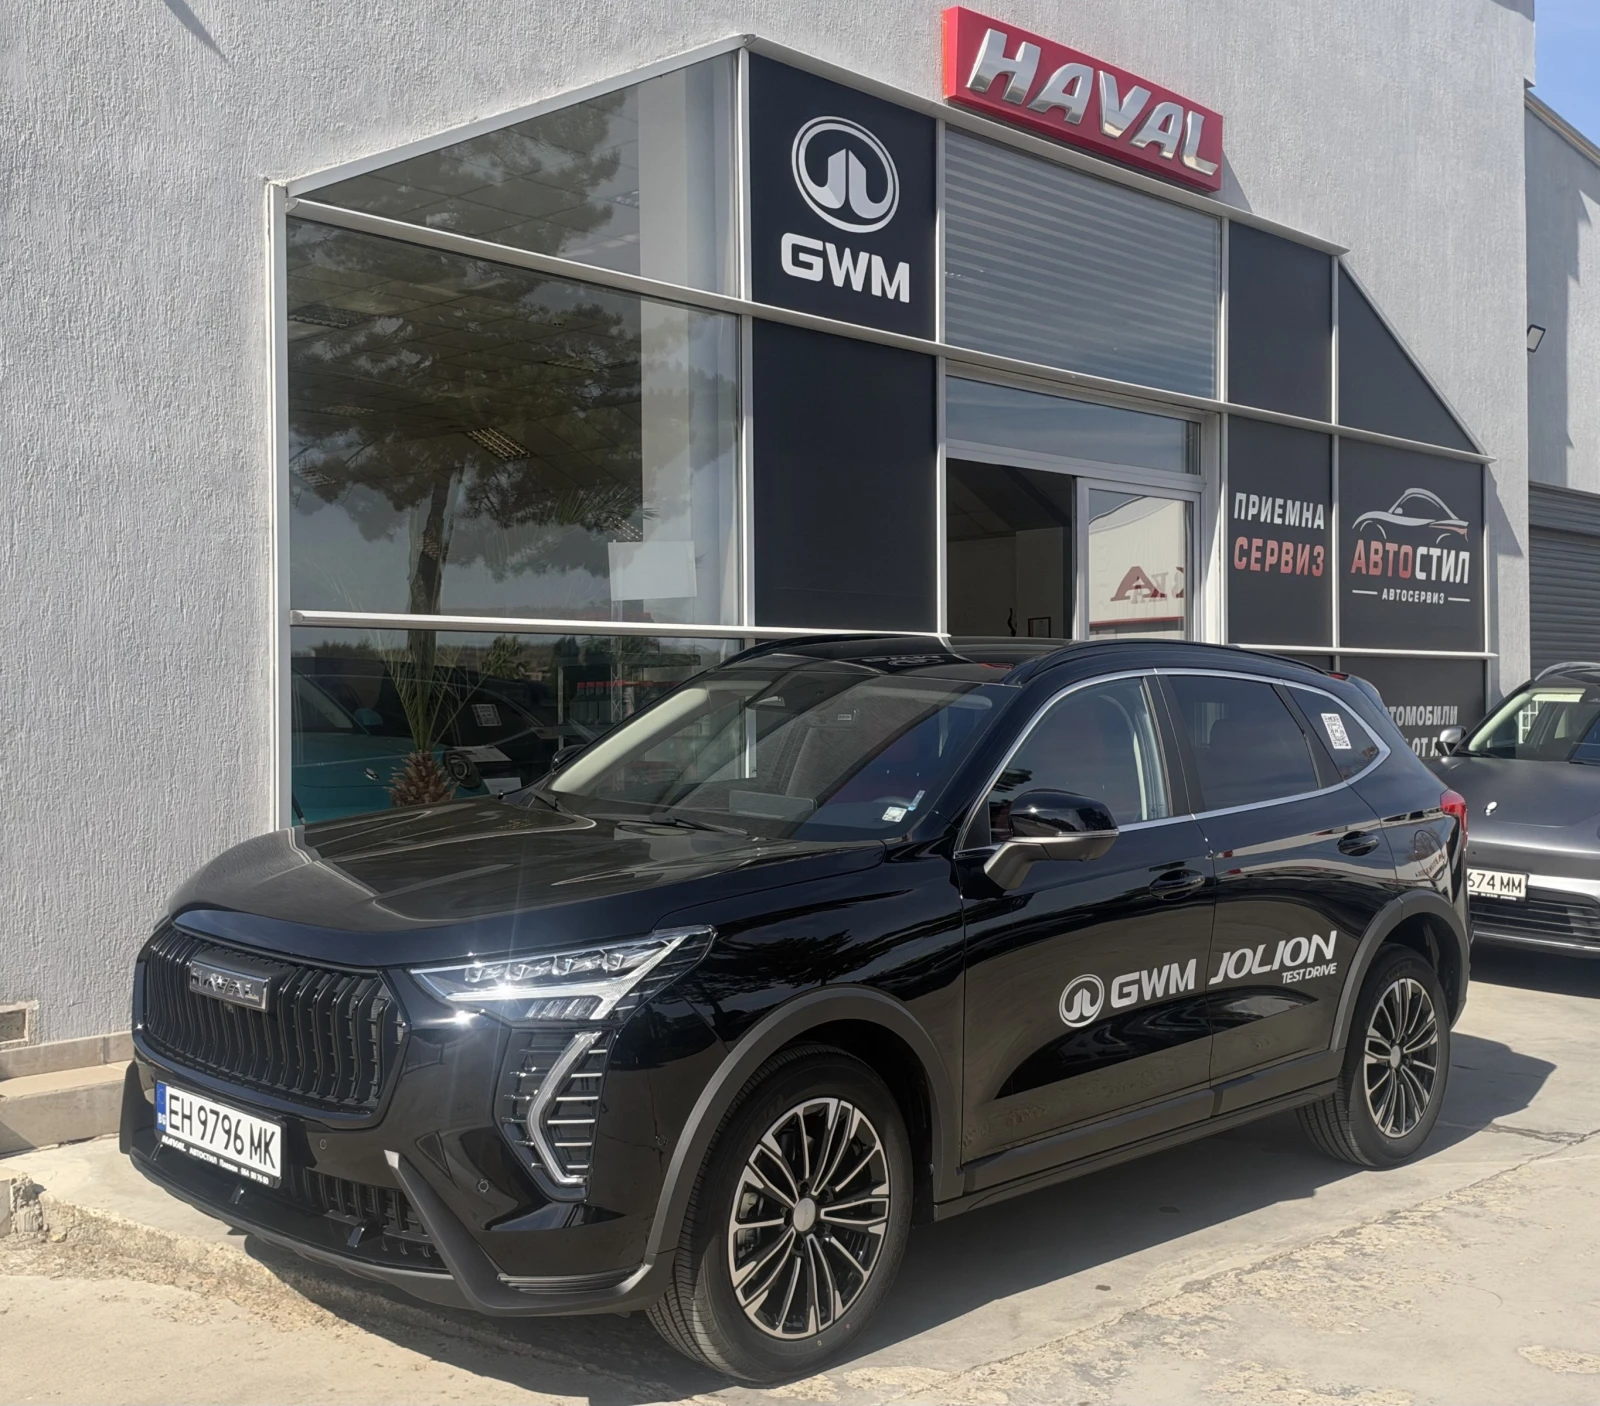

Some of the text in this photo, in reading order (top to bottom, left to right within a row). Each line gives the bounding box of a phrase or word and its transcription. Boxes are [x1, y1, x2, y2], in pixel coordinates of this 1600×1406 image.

[967, 28, 1219, 176] HAVAL
[781, 232, 910, 304] GWM
[1233, 492, 1325, 530] ПРИЕМНА
[1233, 536, 1325, 577] СЕРВИЗ
[1351, 539, 1470, 584] АВТОСТИЛ
[1381, 588, 1445, 604] АВТОСЕРВИЗ
[1385, 705, 1458, 727] ТОМОБИЛИ
[1411, 737, 1429, 757] ОТ
[1499, 875, 1522, 894] MM
[1110, 958, 1197, 1009] GWM
[1208, 930, 1338, 985] JOLION
[1281, 962, 1338, 984] TEST DRIVE
[168, 1093, 276, 1169] EH 9796 MK
